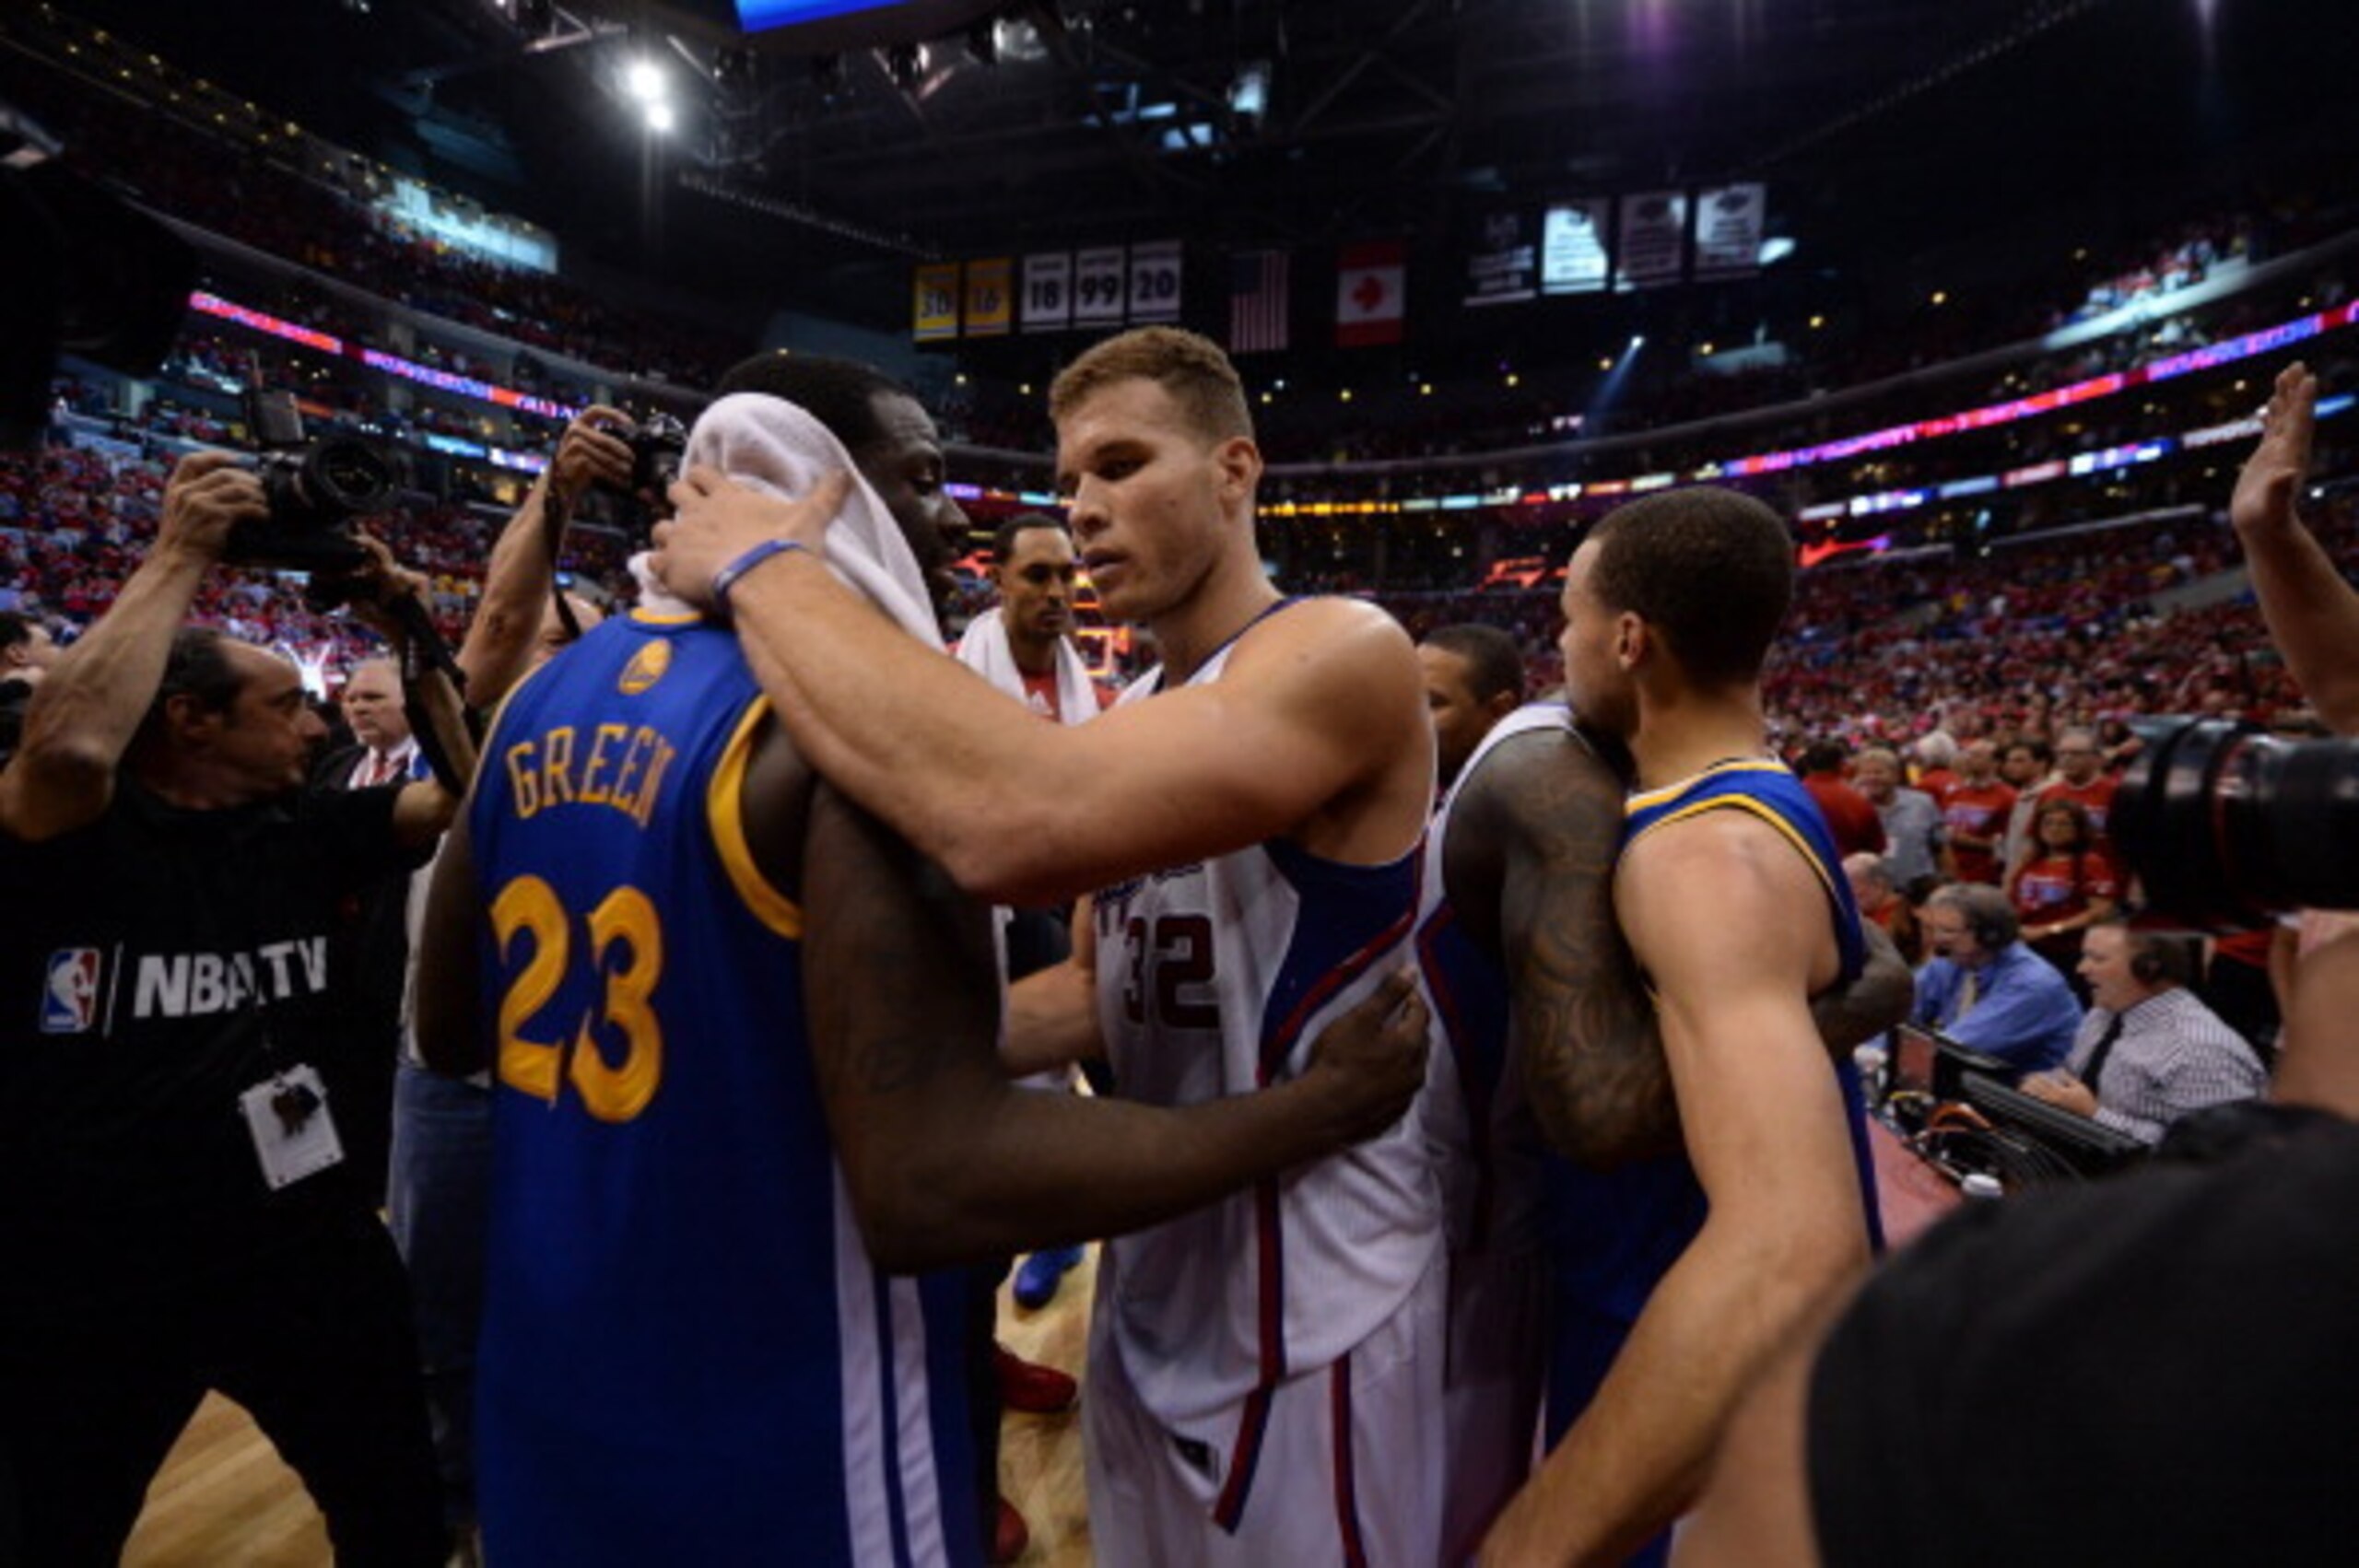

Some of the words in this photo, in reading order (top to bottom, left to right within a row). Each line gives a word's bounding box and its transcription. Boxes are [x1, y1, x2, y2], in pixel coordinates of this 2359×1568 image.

[1031, 280, 1059, 310] 18
[1079, 275, 1118, 305] 99
[1136, 269, 1175, 299] 20
[508, 723, 675, 829] GREEN
[134, 953, 267, 1017] NBA
[259, 936, 326, 998] TV
[490, 873, 663, 1123] 23
[1124, 916, 1219, 1027] 32
